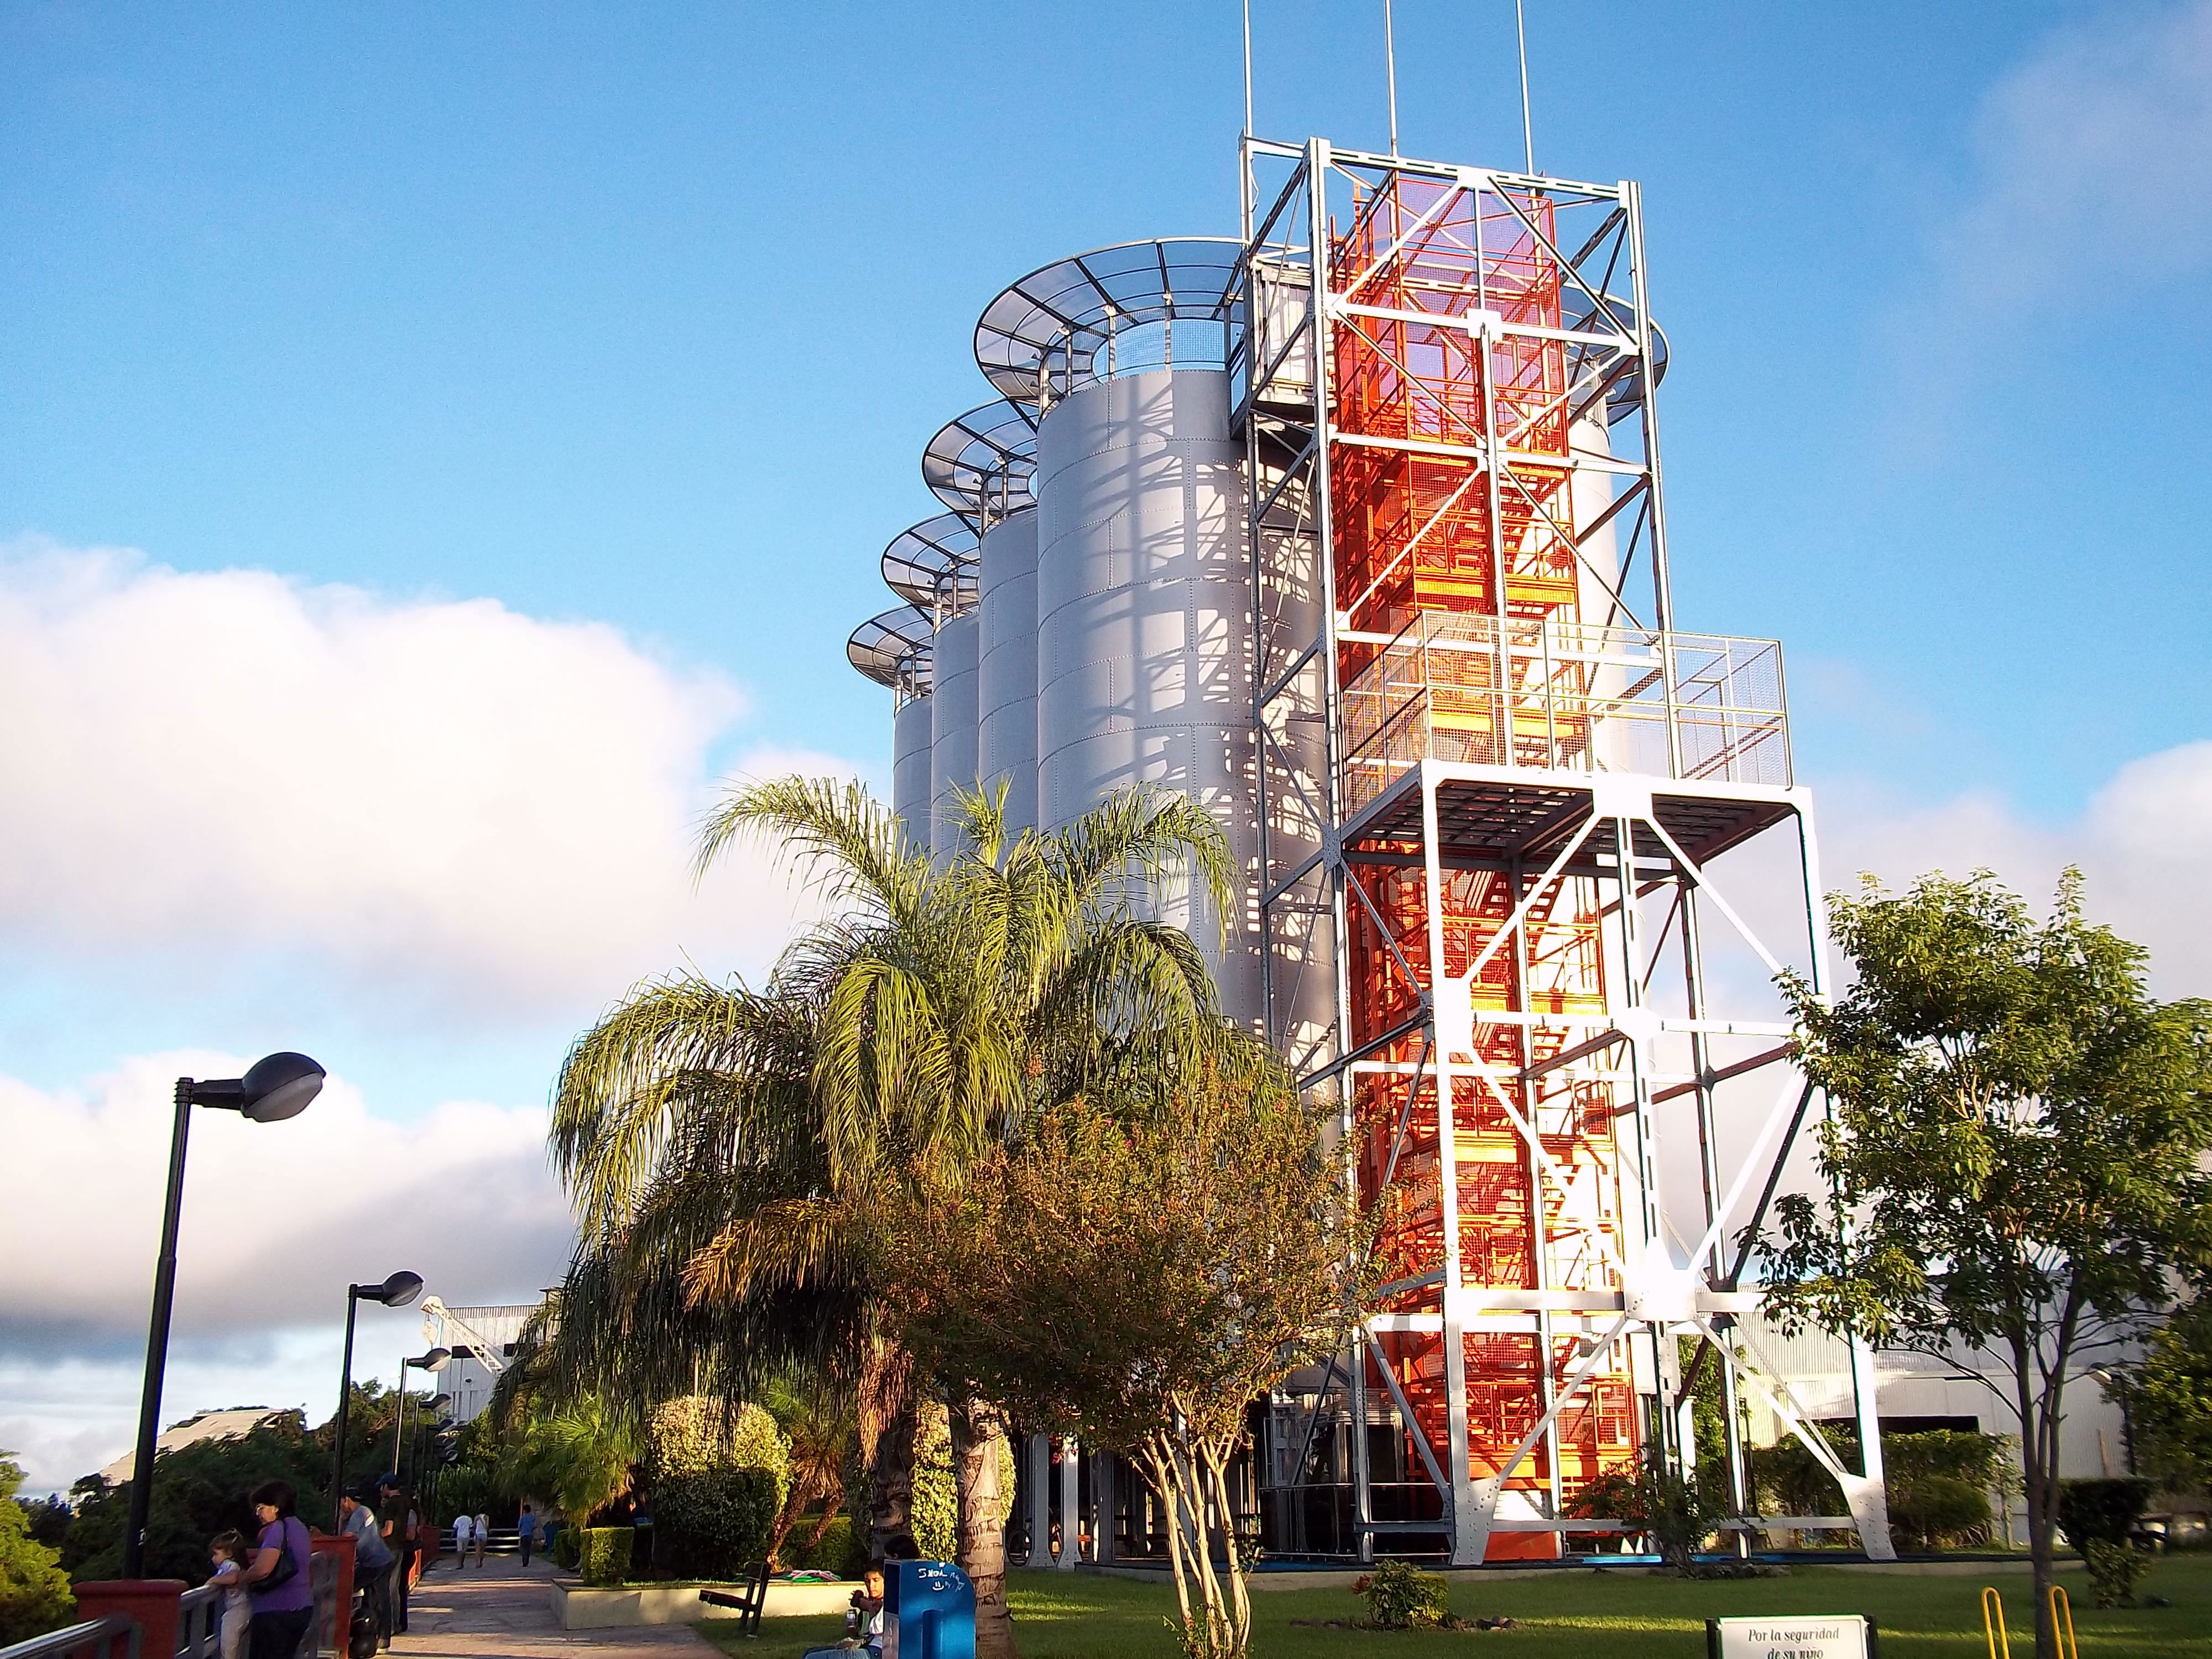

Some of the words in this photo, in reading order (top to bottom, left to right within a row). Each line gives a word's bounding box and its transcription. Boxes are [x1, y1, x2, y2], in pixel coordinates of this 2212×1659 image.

[1748, 1629, 1768, 1642] Por
[1771, 1629, 1781, 1641] la
[1784, 1627, 1839, 1644] seguridad
[1767, 1647, 1781, 1659] de
[1783, 1650, 1796, 1659] su
[1799, 1646, 1824, 1659] niño
